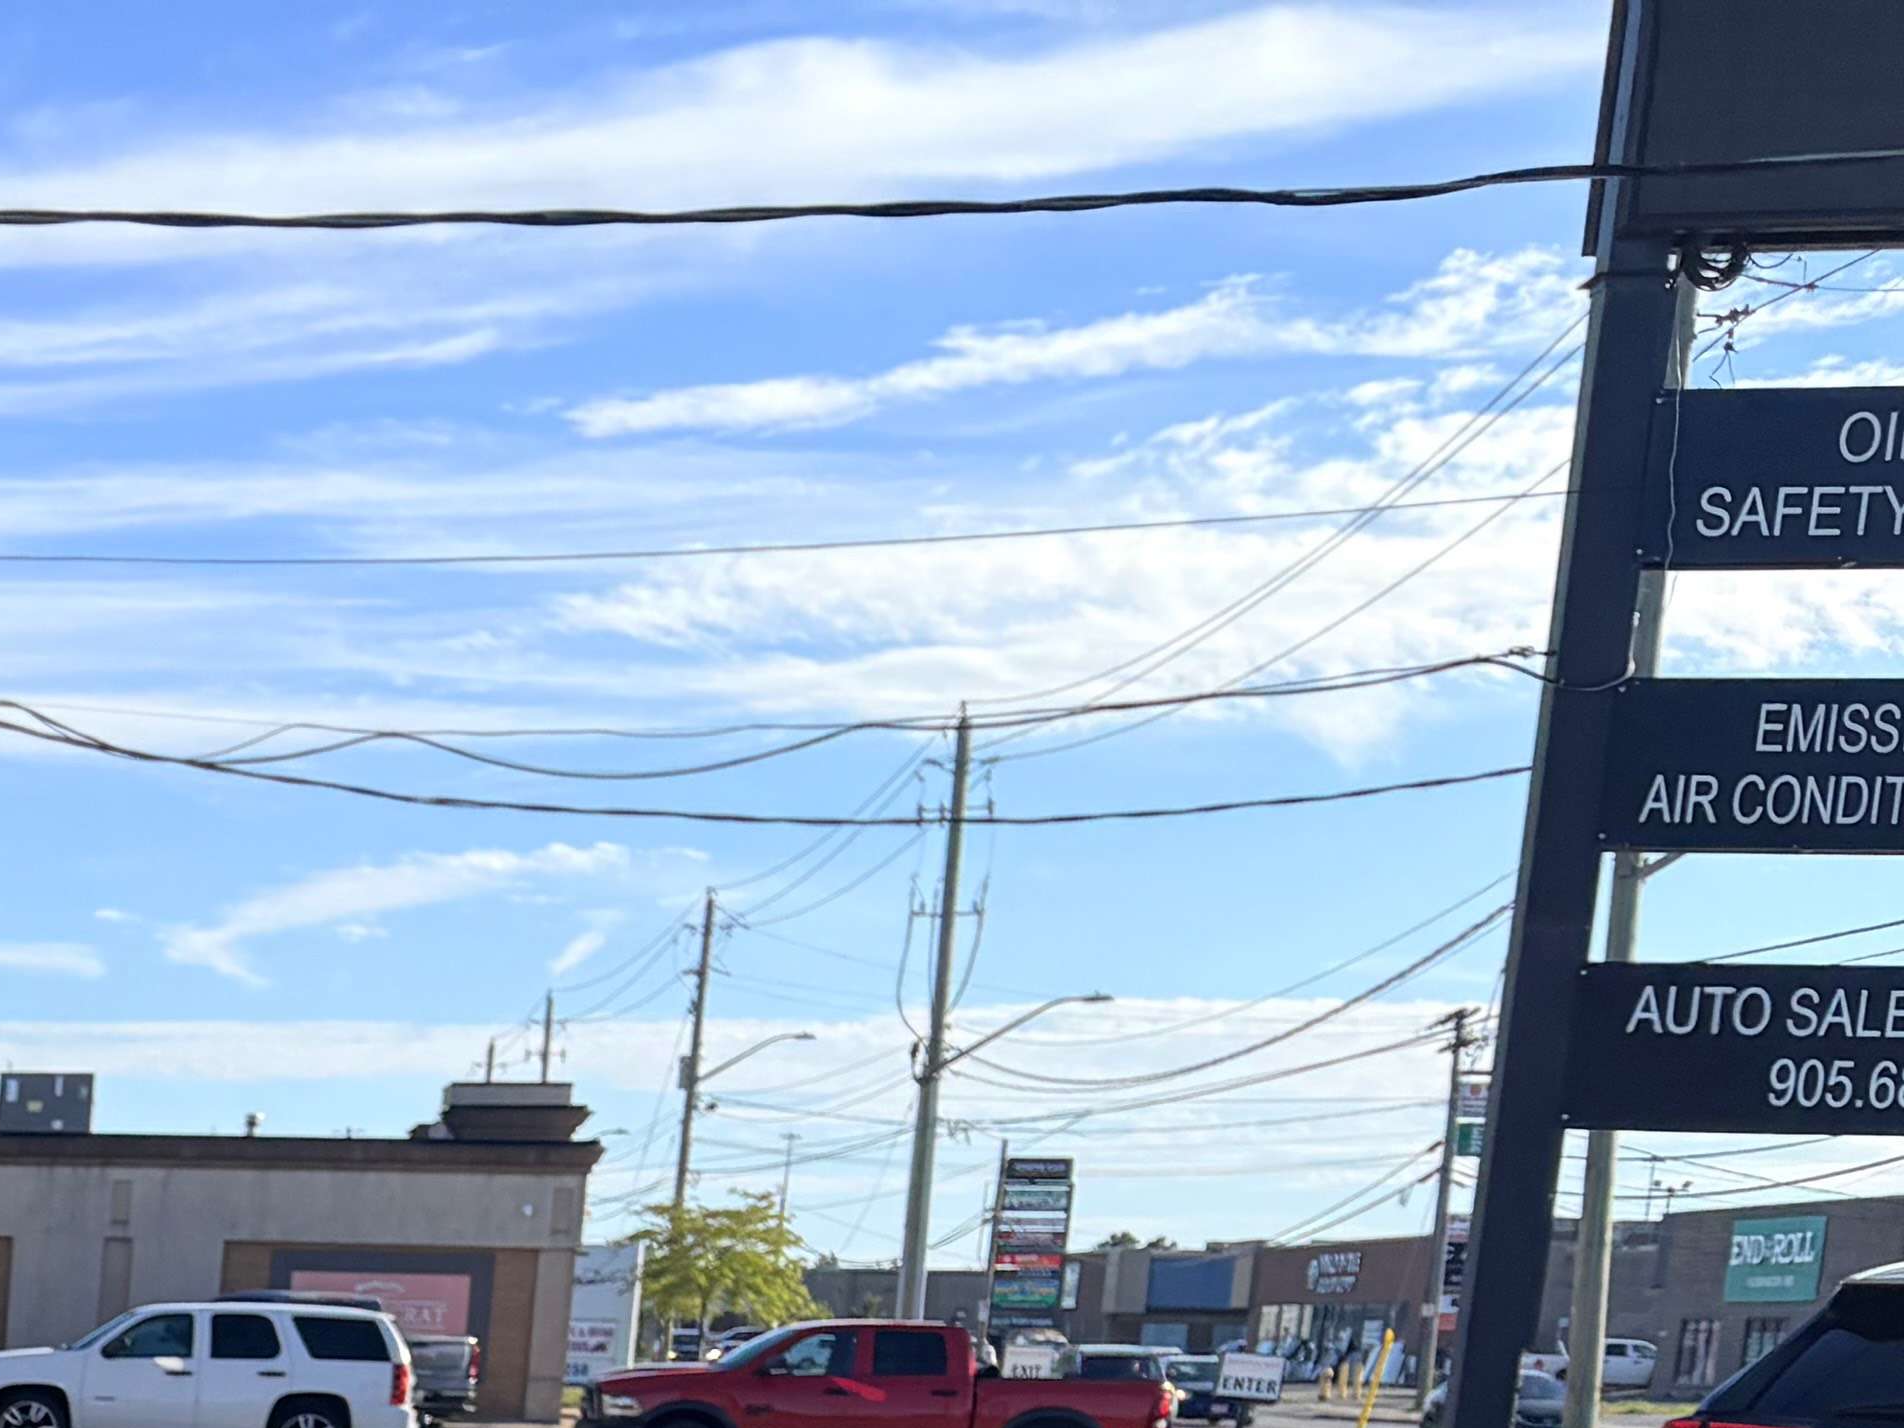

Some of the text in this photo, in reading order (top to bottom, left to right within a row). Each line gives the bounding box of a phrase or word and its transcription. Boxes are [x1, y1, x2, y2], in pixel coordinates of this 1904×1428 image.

[1839, 411, 1904, 463] OI
[1696, 485, 1904, 536] SAFETY
[1755, 703, 1904, 753] EMISS
[1638, 774, 1904, 825] AIR CONDIT
[1625, 985, 1904, 1038] AUTO SALE
[1768, 1058, 1904, 1109] 905.6
[1222, 1376, 1278, 1395] ENTER
